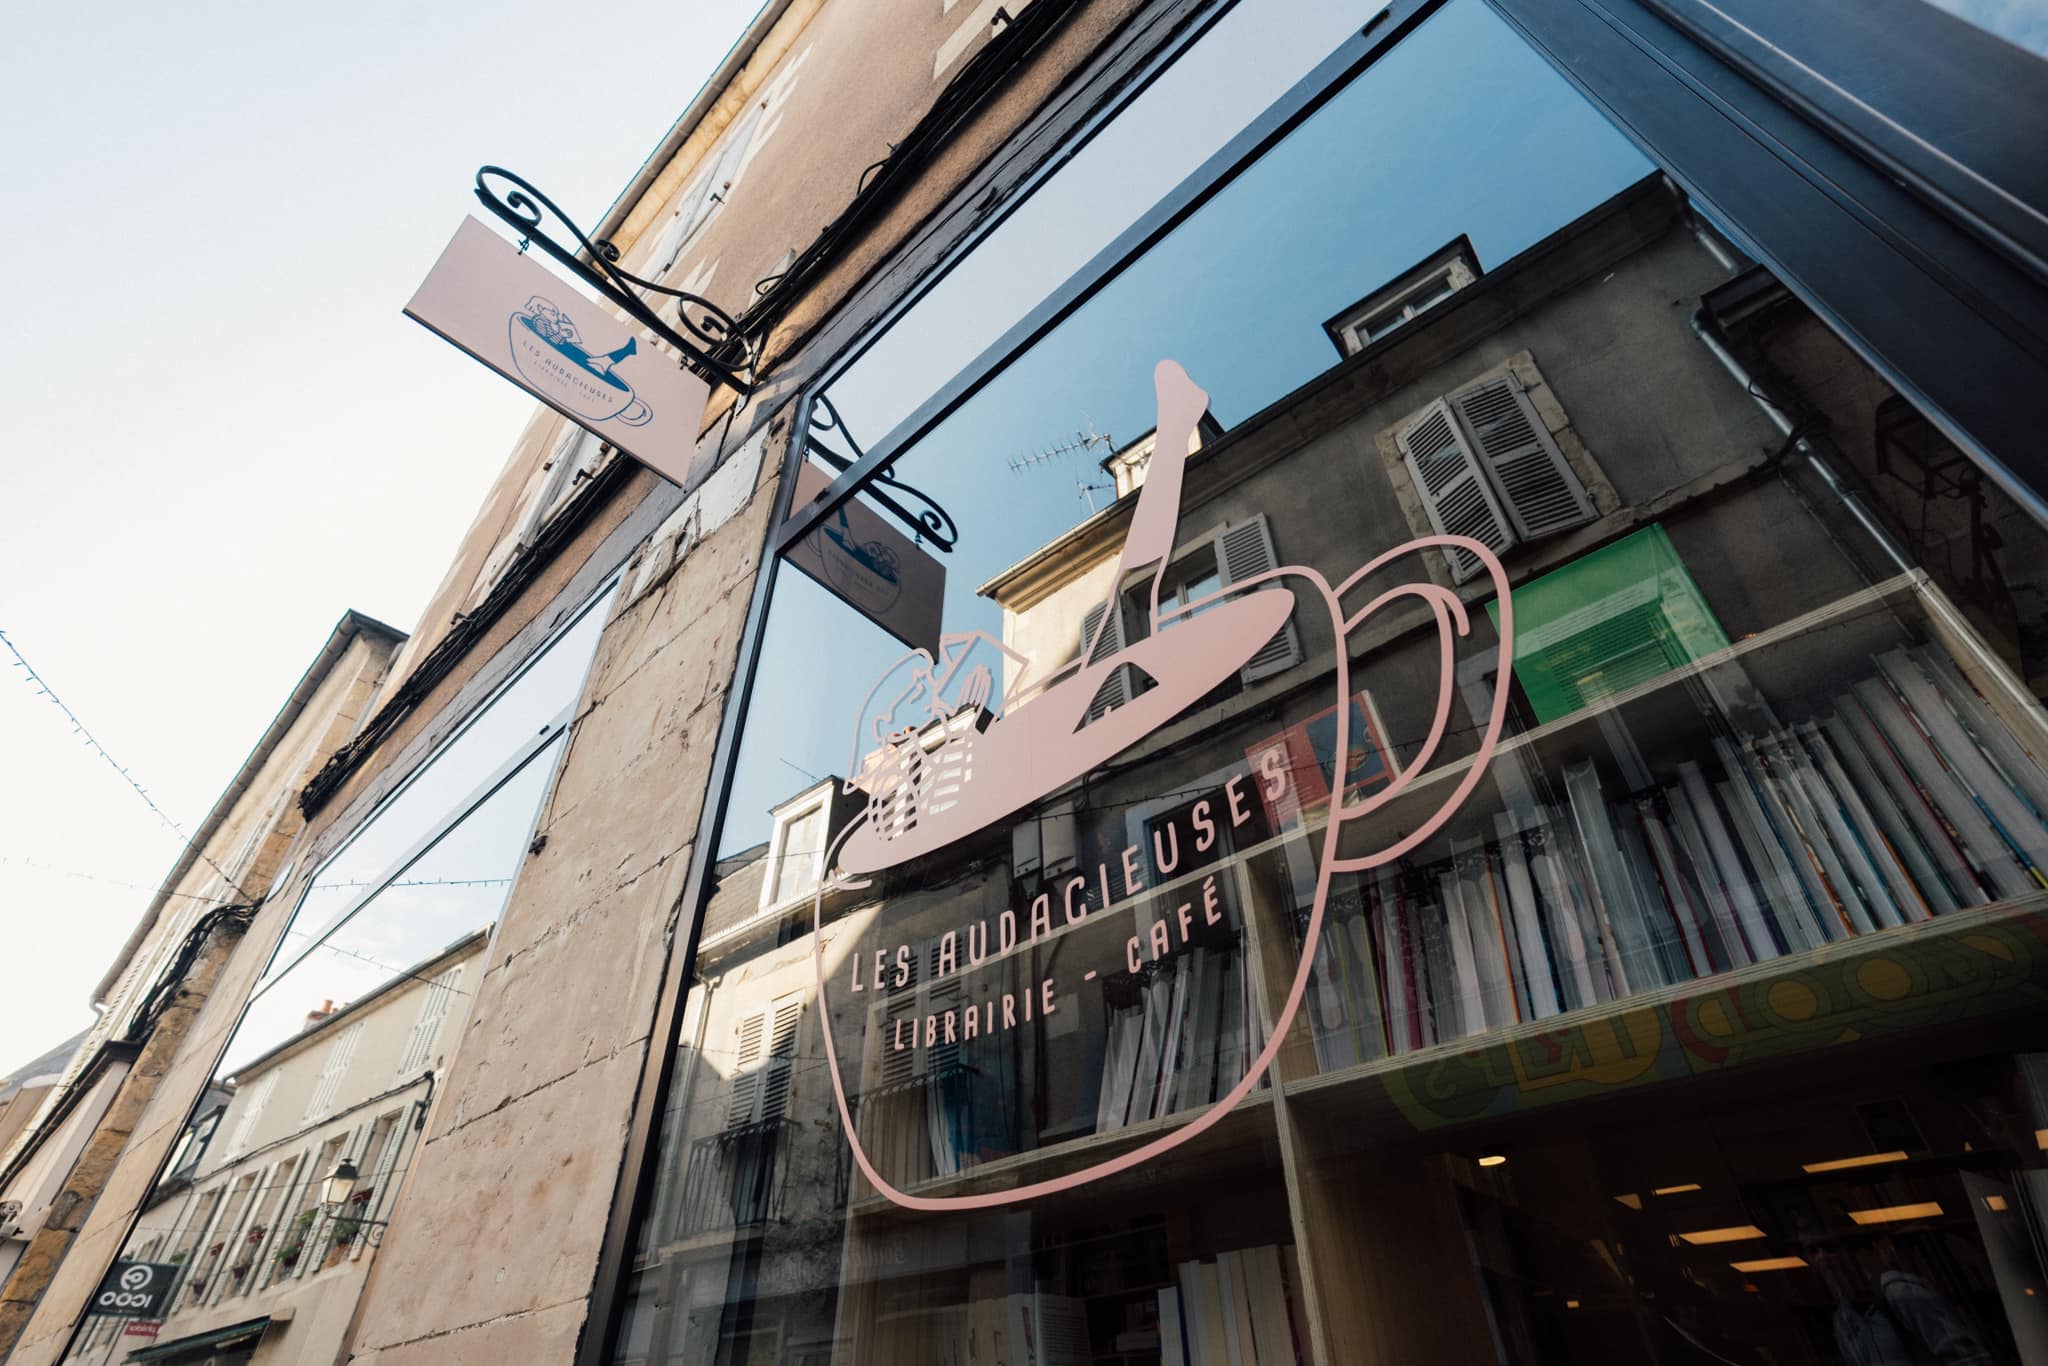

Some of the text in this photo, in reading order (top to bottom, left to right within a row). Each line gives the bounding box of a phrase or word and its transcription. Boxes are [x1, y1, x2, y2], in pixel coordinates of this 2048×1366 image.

[850, 745, 1289, 993] LES AUDACIEUSES
[893, 977, 1057, 1051] LIBRAIRIE
[1126, 875, 1223, 975] CAFÉ
